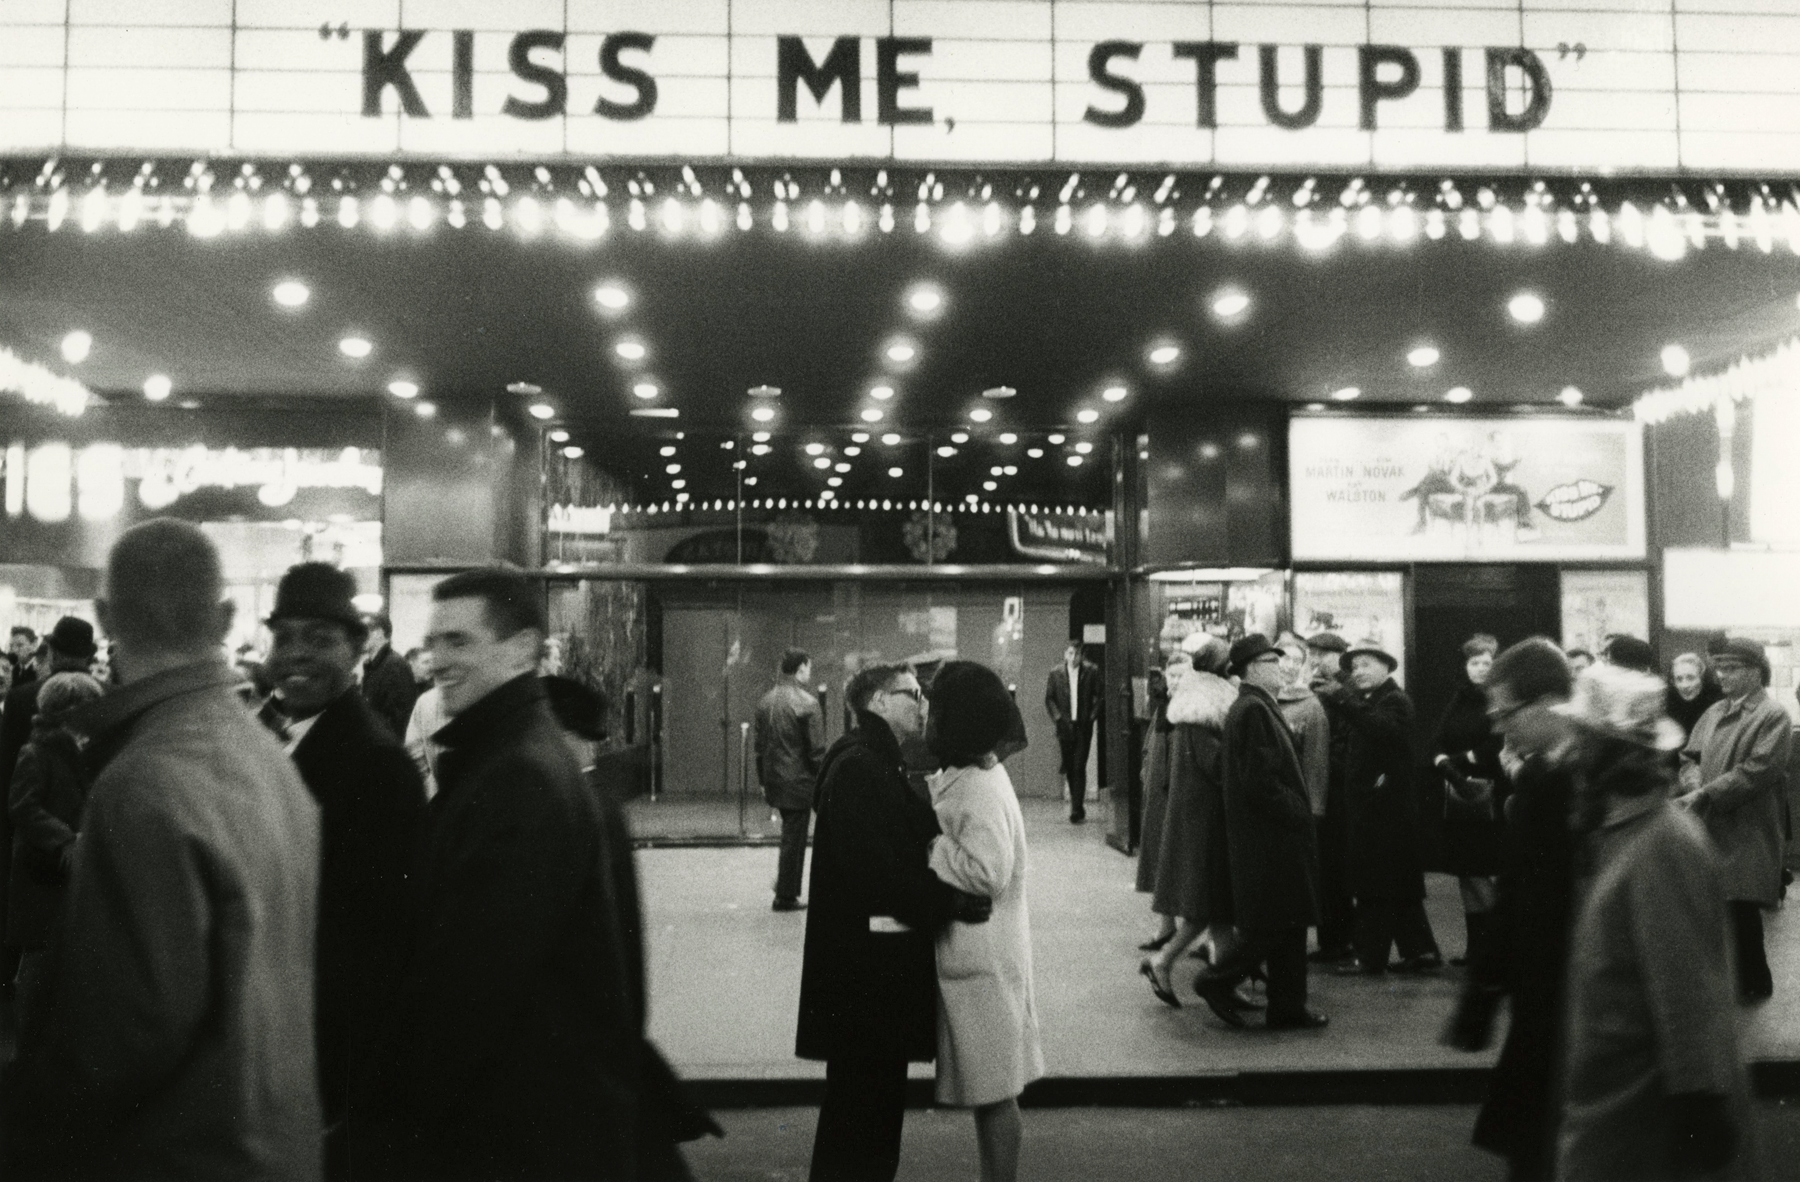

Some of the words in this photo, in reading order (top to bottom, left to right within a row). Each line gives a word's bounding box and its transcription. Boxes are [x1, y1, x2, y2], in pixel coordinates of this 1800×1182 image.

[318, 21, 660, 122] “KISS
[776, 34, 956, 134] ME,
[1082, 39, 1588, 133] STUPID”
[1305, 464, 1354, 478] MARTIN
[1363, 464, 1405, 478] NOVAK
[1326, 489, 1387, 502] WALSTON
